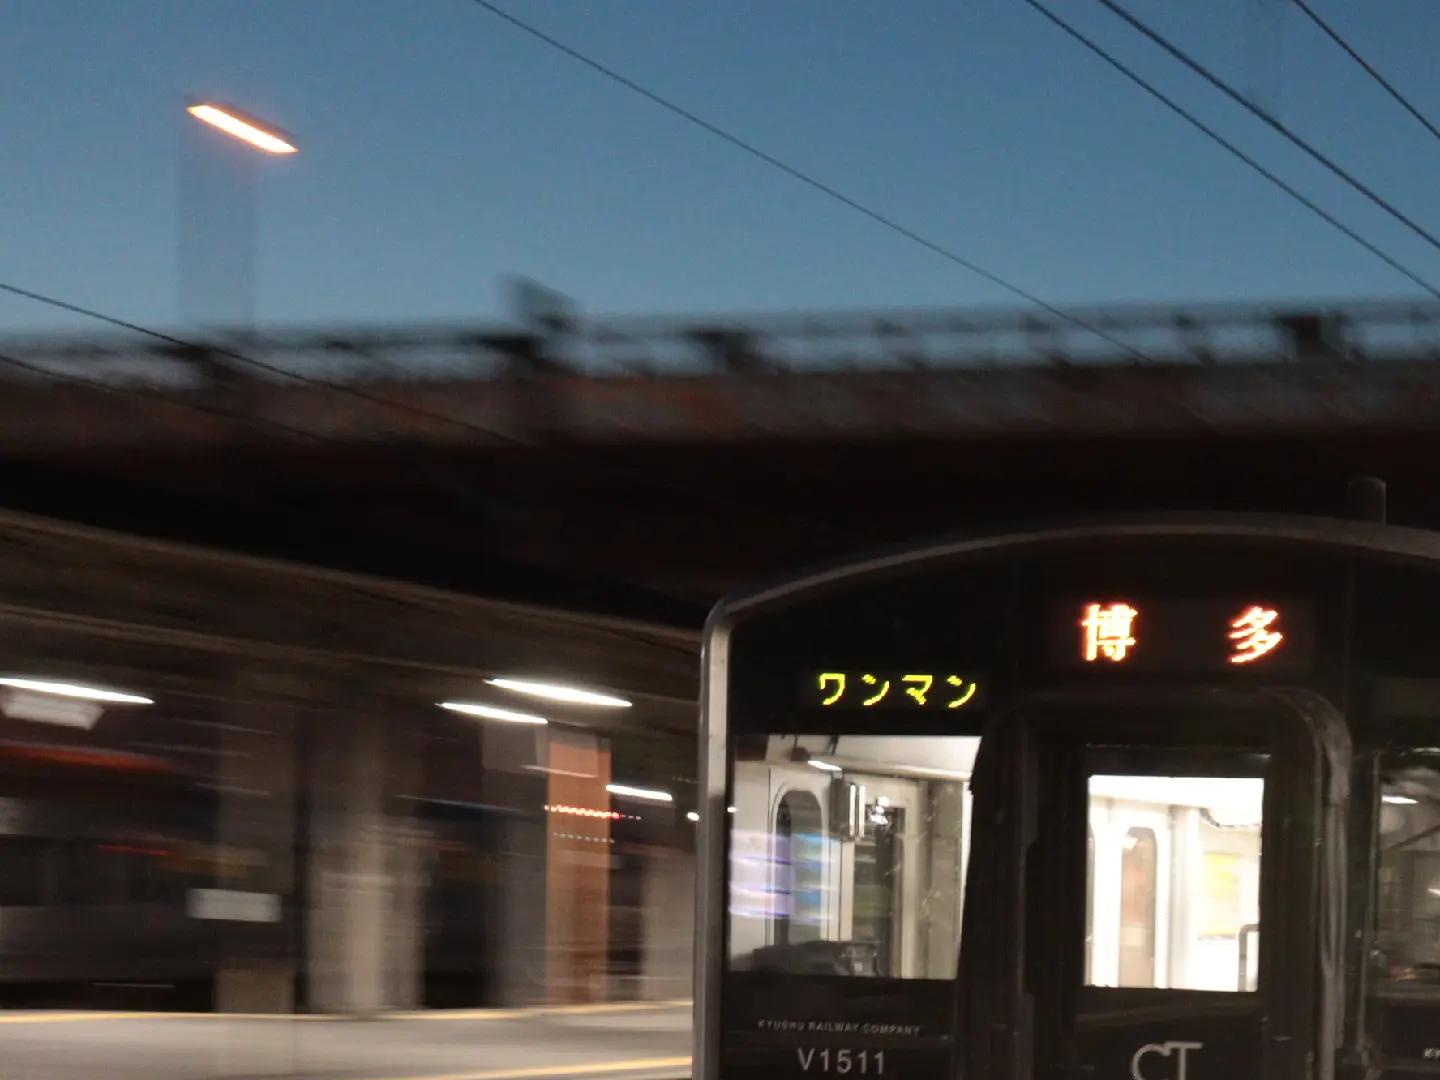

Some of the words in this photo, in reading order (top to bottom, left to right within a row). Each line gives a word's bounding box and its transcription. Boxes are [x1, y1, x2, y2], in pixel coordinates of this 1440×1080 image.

[818, 672, 976, 708] ワンマン
[807, 1021, 859, 1033] RAILWAY
[862, 1023, 920, 1036] COMPANY
[797, 1047, 884, 1075] V1511
